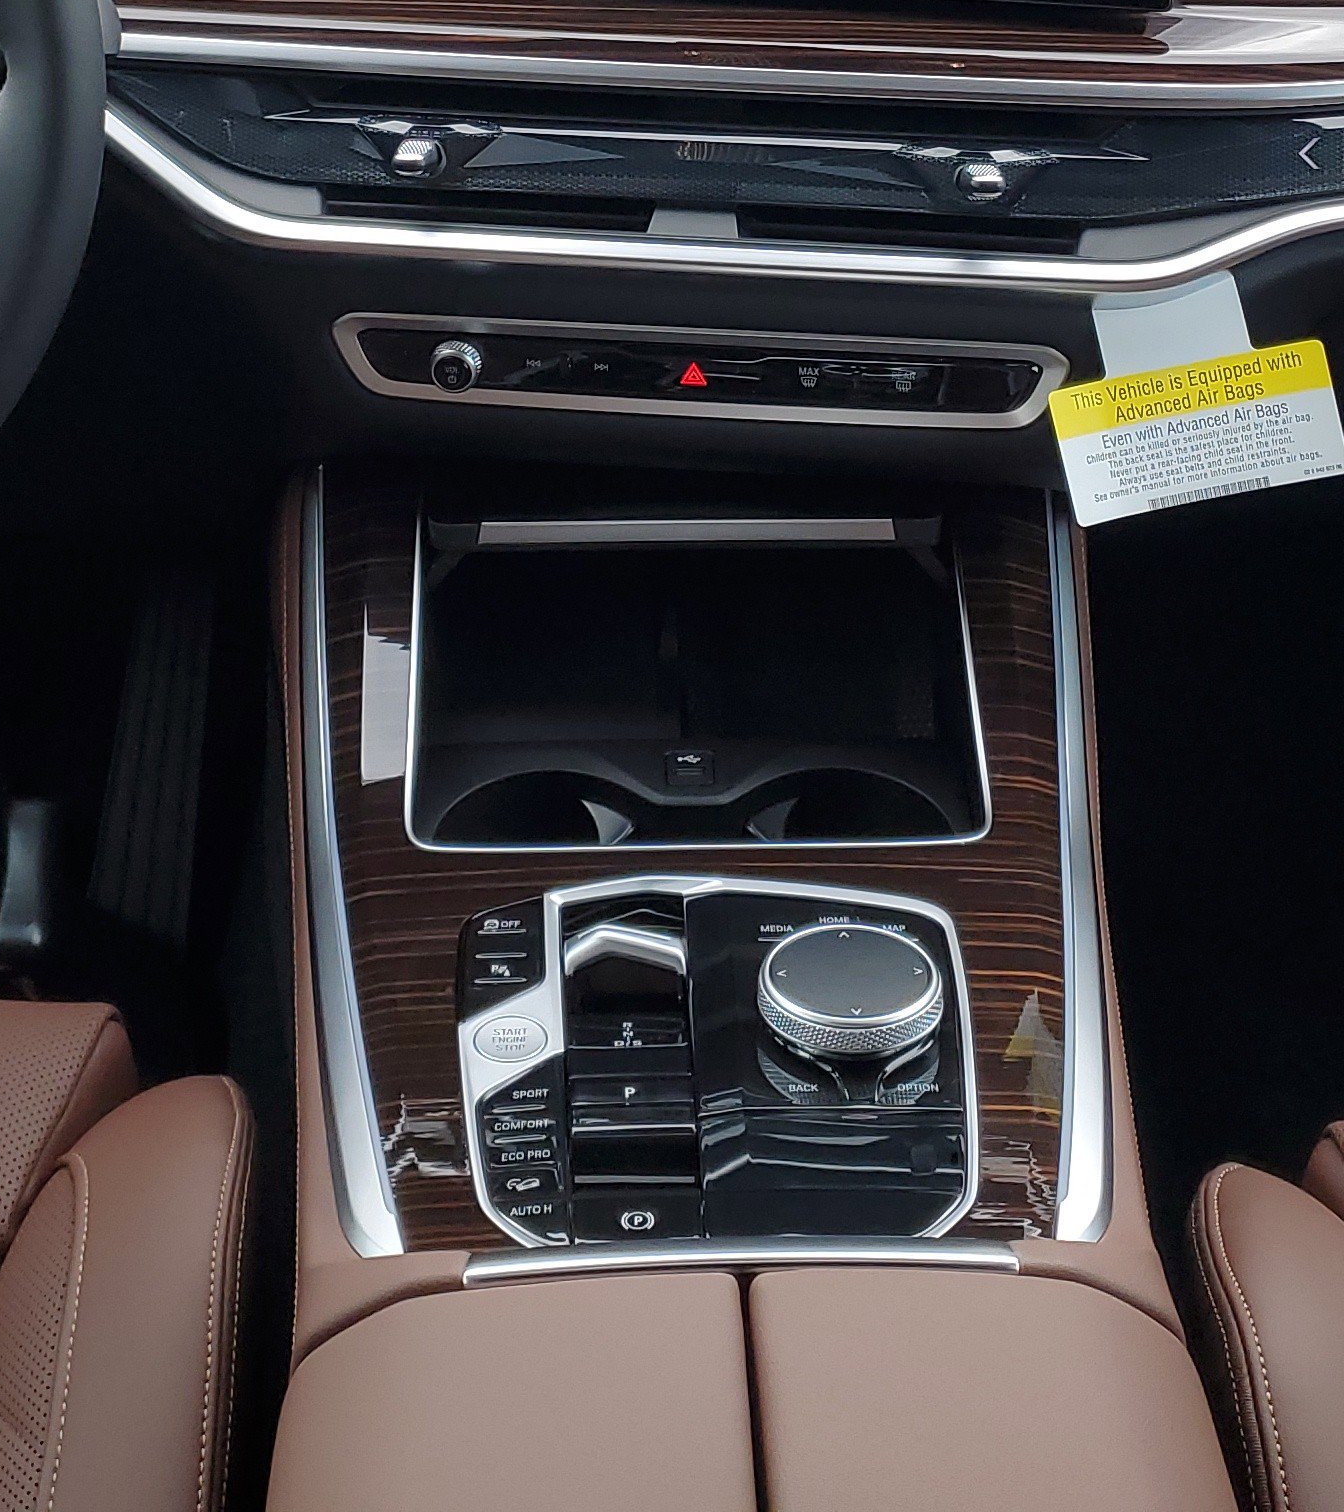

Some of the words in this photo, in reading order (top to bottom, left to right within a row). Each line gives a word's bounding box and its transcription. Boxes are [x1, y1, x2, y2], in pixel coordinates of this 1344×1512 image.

[798, 366, 820, 376] MAX
[1071, 391, 1103, 410] This
[1106, 378, 1164, 402] Vehicle
[1168, 373, 1183, 390] is
[1187, 357, 1262, 387] Equipped
[1266, 351, 1302, 371] with
[1115, 392, 1191, 423] Advanced
[1197, 388, 1219, 407] Air
[1224, 381, 1264, 401] Bags
[1101, 432, 1132, 449] Even
[1135, 425, 1163, 442] with
[1167, 410, 1230, 436] Advanced
[1234, 406, 1252, 423] Air
[1255, 402, 1289, 419] Bags
[1086, 451, 1117, 465] Children
[1119, 447, 1134, 457] can
[1136, 445, 1146, 454] be
[1147, 439, 1170, 451] killed
[1172, 437, 1180, 446] or
[1183, 430, 1220, 444] seriously
[1222, 423, 1251, 436] injured
[1253, 421, 1263, 432] by
[1266, 418, 1279, 427] the
[1282, 416, 1293, 425] air
[1295, 413, 1314, 423] bag.
[1108, 460, 1123, 469] The
[1126, 454, 1145, 465] back
[1146, 451, 1164, 461] seat
[1166, 448, 1173, 457] is
[1175, 445, 1188, 454] the
[1190, 441, 1215, 452] safest
[1217, 436, 1239, 447] place
[1241, 433, 1253, 442] for
[1256, 427, 1293, 440] children.
[1110, 467, 1133, 479] Never
[1135, 464, 1149, 475] put
[1158, 453, 1203, 469] rear-facing
[1204, 448, 1224, 459] child
[1227, 445, 1244, 455] seat
[1246, 443, 1254, 451] in
[1256, 440, 1269, 449] the
[1271, 435, 1295, 446] front.
[1119, 474, 1147, 487] Always
[1149, 471, 1164, 480] use
[1166, 468, 1183, 477] seat
[1185, 463, 1205, 474] belts
[1207, 459, 1222, 468] and
[1225, 454, 1245, 466] child
[1247, 447, 1290, 460] restraints.
[1110, 486, 1140, 499] owner's
[1141, 479, 1171, 492] manual
[1173, 476, 1185, 485] for
[1187, 472, 1208, 483] more
[1210, 462, 1258, 477] information
[1260, 456, 1284, 468] about
[1286, 454, 1296, 463] air
[1299, 451, 1323, 461] bags.
[500, 920, 521, 928] OFF
[819, 916, 850, 924] HOME
[760, 924, 794, 933] MEDIA
[882, 924, 906, 932] MAP
[493, 1028, 528, 1036] START
[491, 1036, 528, 1044] ENGINE
[624, 1086, 636, 1098] P
[788, 1083, 818, 1092] BACK
[897, 1083, 940, 1093] OPTION
[512, 1089, 549, 1099] SPORT
[494, 1119, 549, 1131] COMFORT
[501, 1151, 524, 1162] ECO
[527, 1149, 551, 1160] PRO
[510, 1205, 541, 1217] AUTO
[543, 1204, 553, 1214] H
